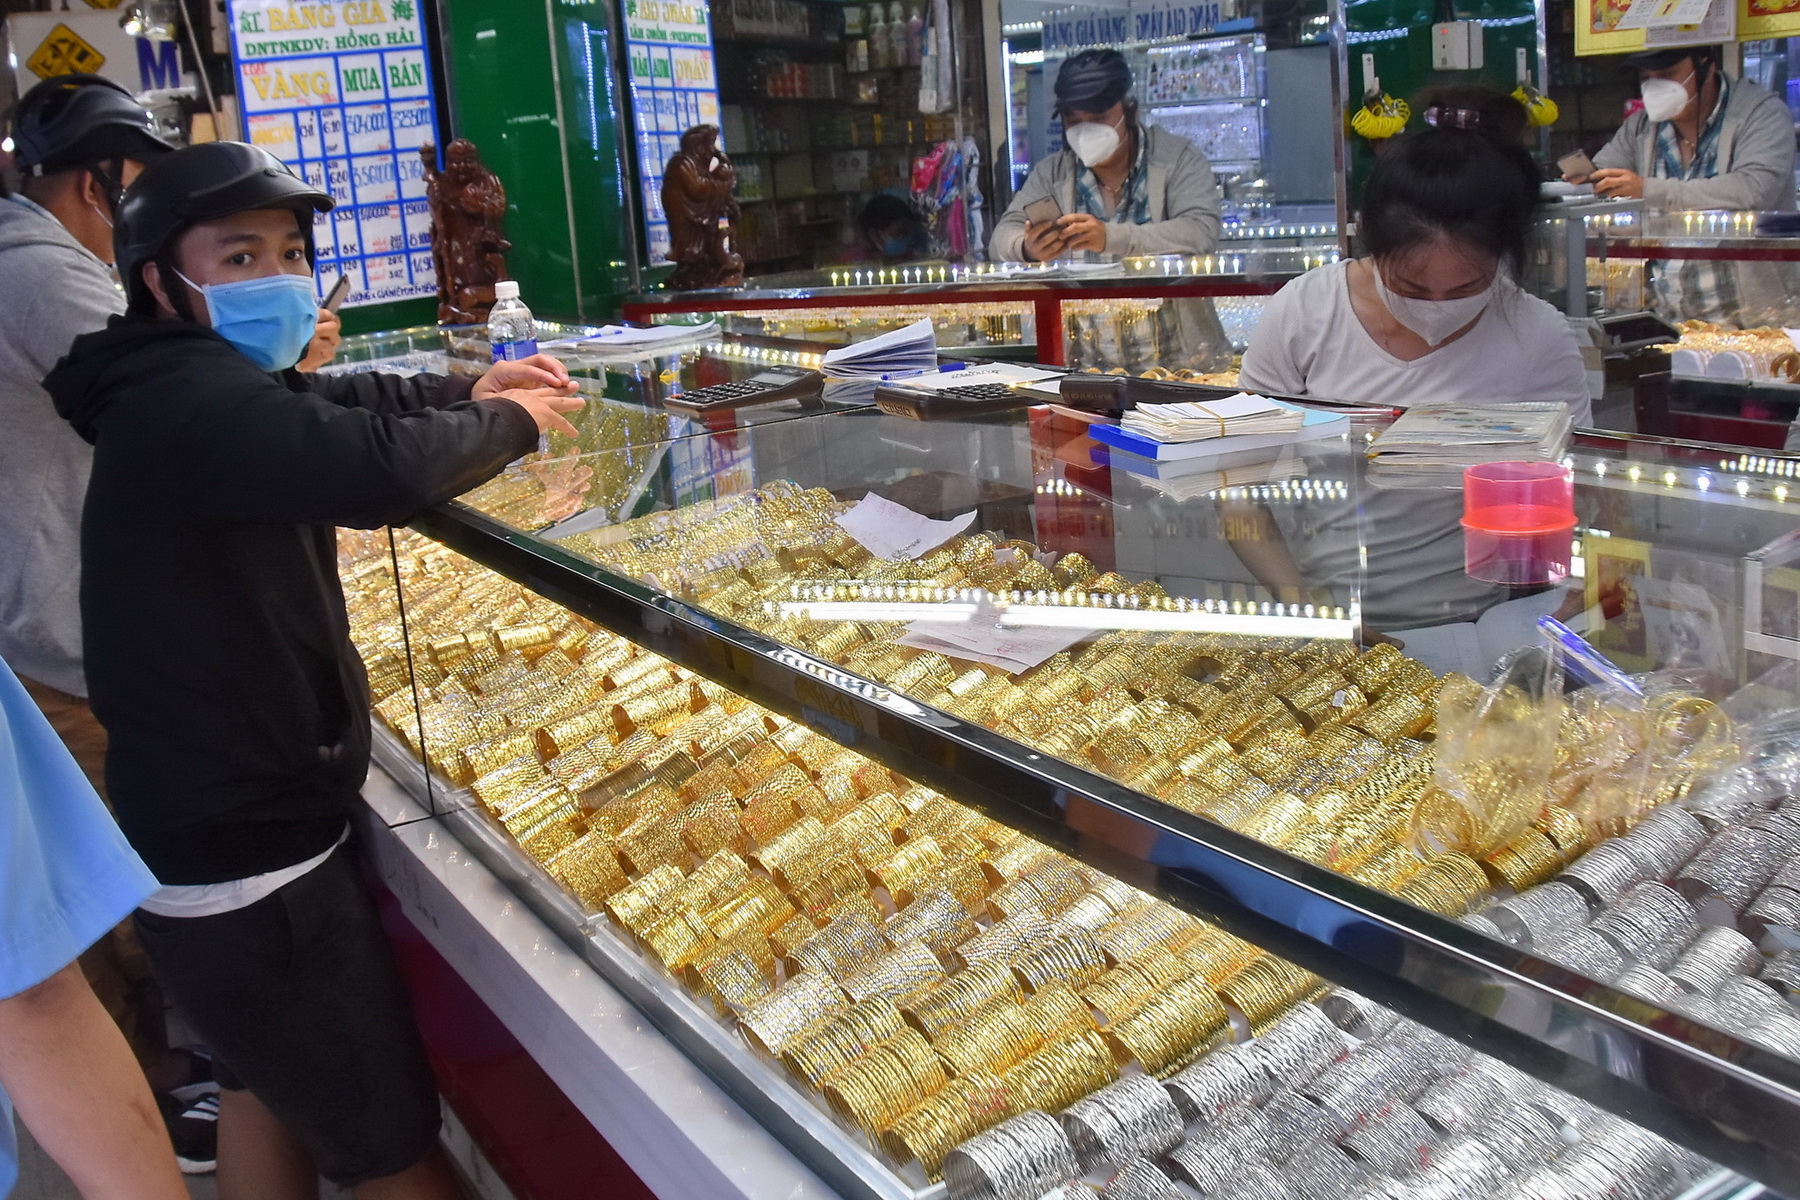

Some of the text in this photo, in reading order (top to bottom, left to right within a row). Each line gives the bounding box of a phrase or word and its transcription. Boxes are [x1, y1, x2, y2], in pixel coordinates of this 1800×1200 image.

[335, 29, 380, 49] HỒNG
[387, 27, 415, 44] HẢI
[251, 67, 331, 100] VÀNG
[343, 68, 381, 92] MUA
[389, 57, 422, 87] BÁN
[881, 402, 913, 418] CASIO
